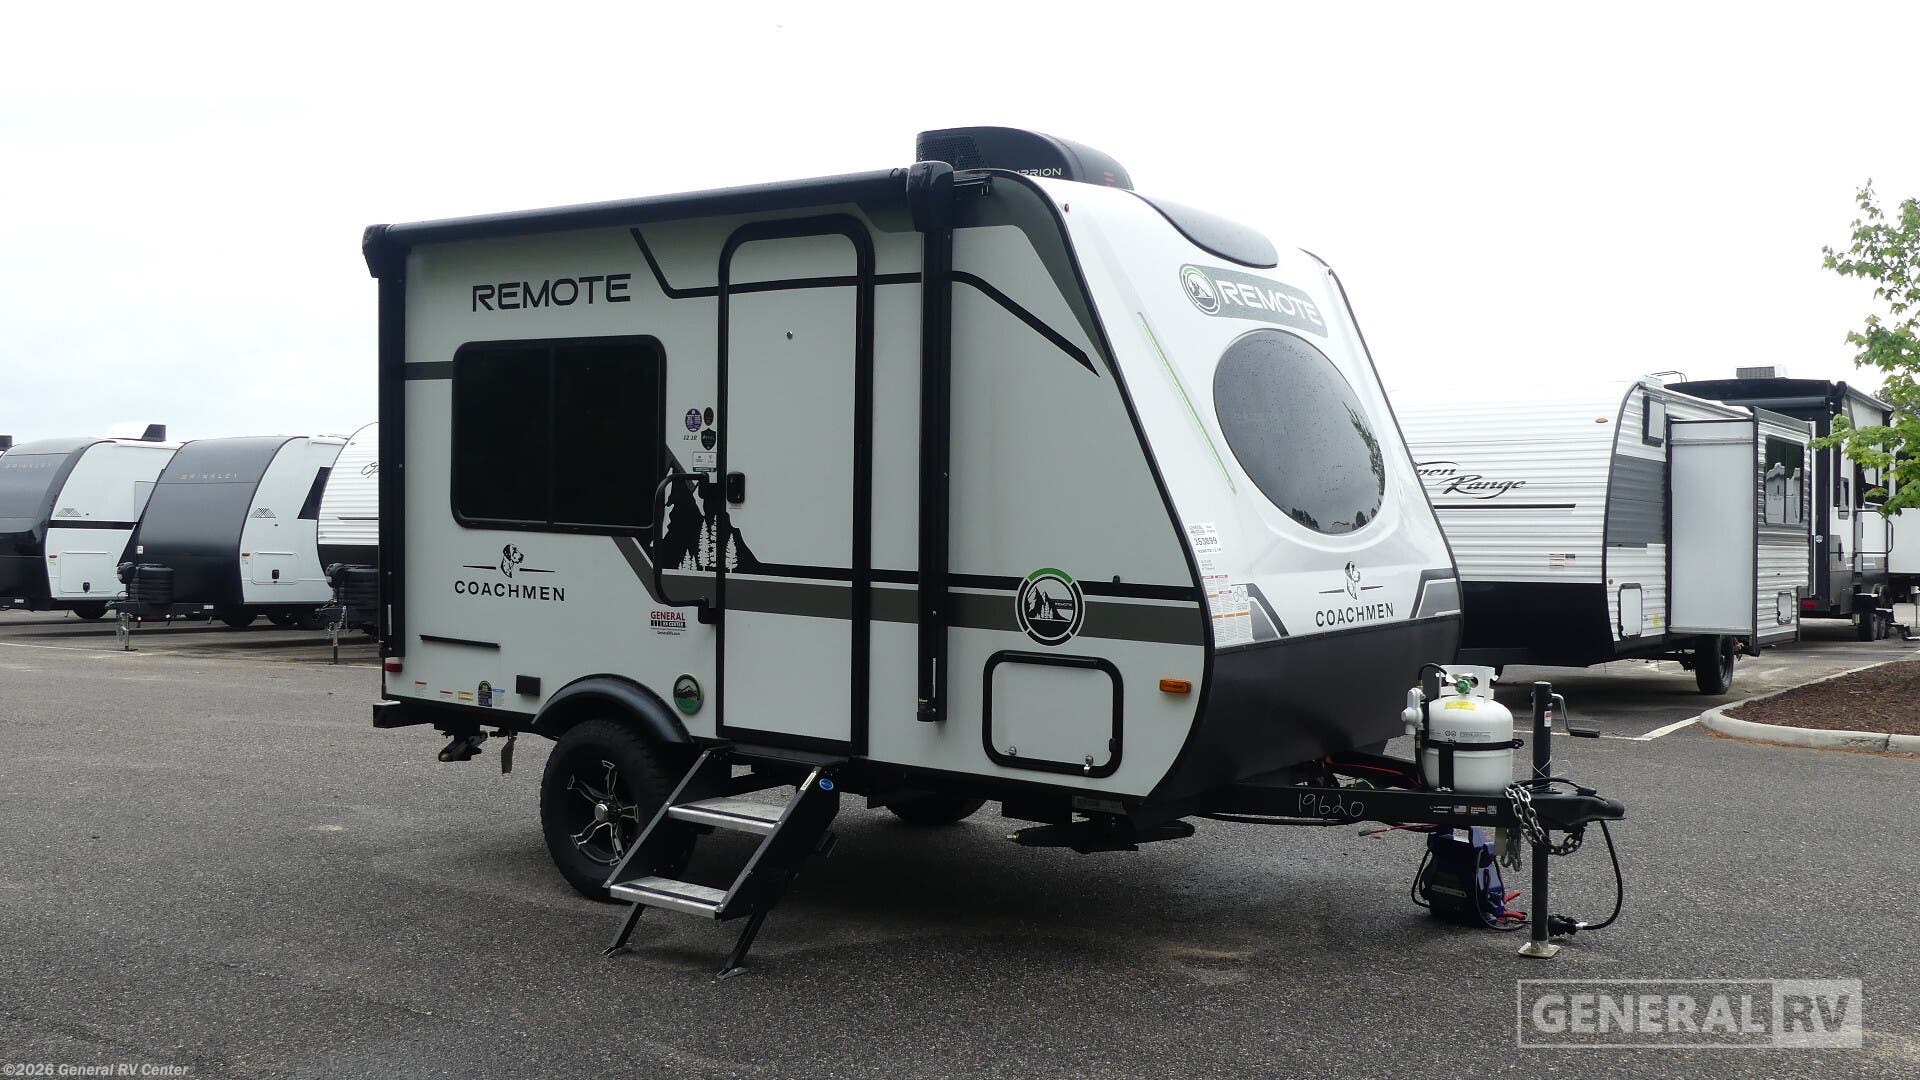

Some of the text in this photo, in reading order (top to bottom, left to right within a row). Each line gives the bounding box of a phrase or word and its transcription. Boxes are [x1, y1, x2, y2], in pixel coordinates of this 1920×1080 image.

[472, 273, 632, 312] REMOTE
[1215, 279, 1323, 327] REMOTE
[1435, 474, 1527, 500] Range
[454, 580, 565, 601] COACHMEN
[650, 611, 686, 621] GENERAL
[1315, 602, 1394, 627] COACHMEN
[1298, 793, 1364, 817] 19620
